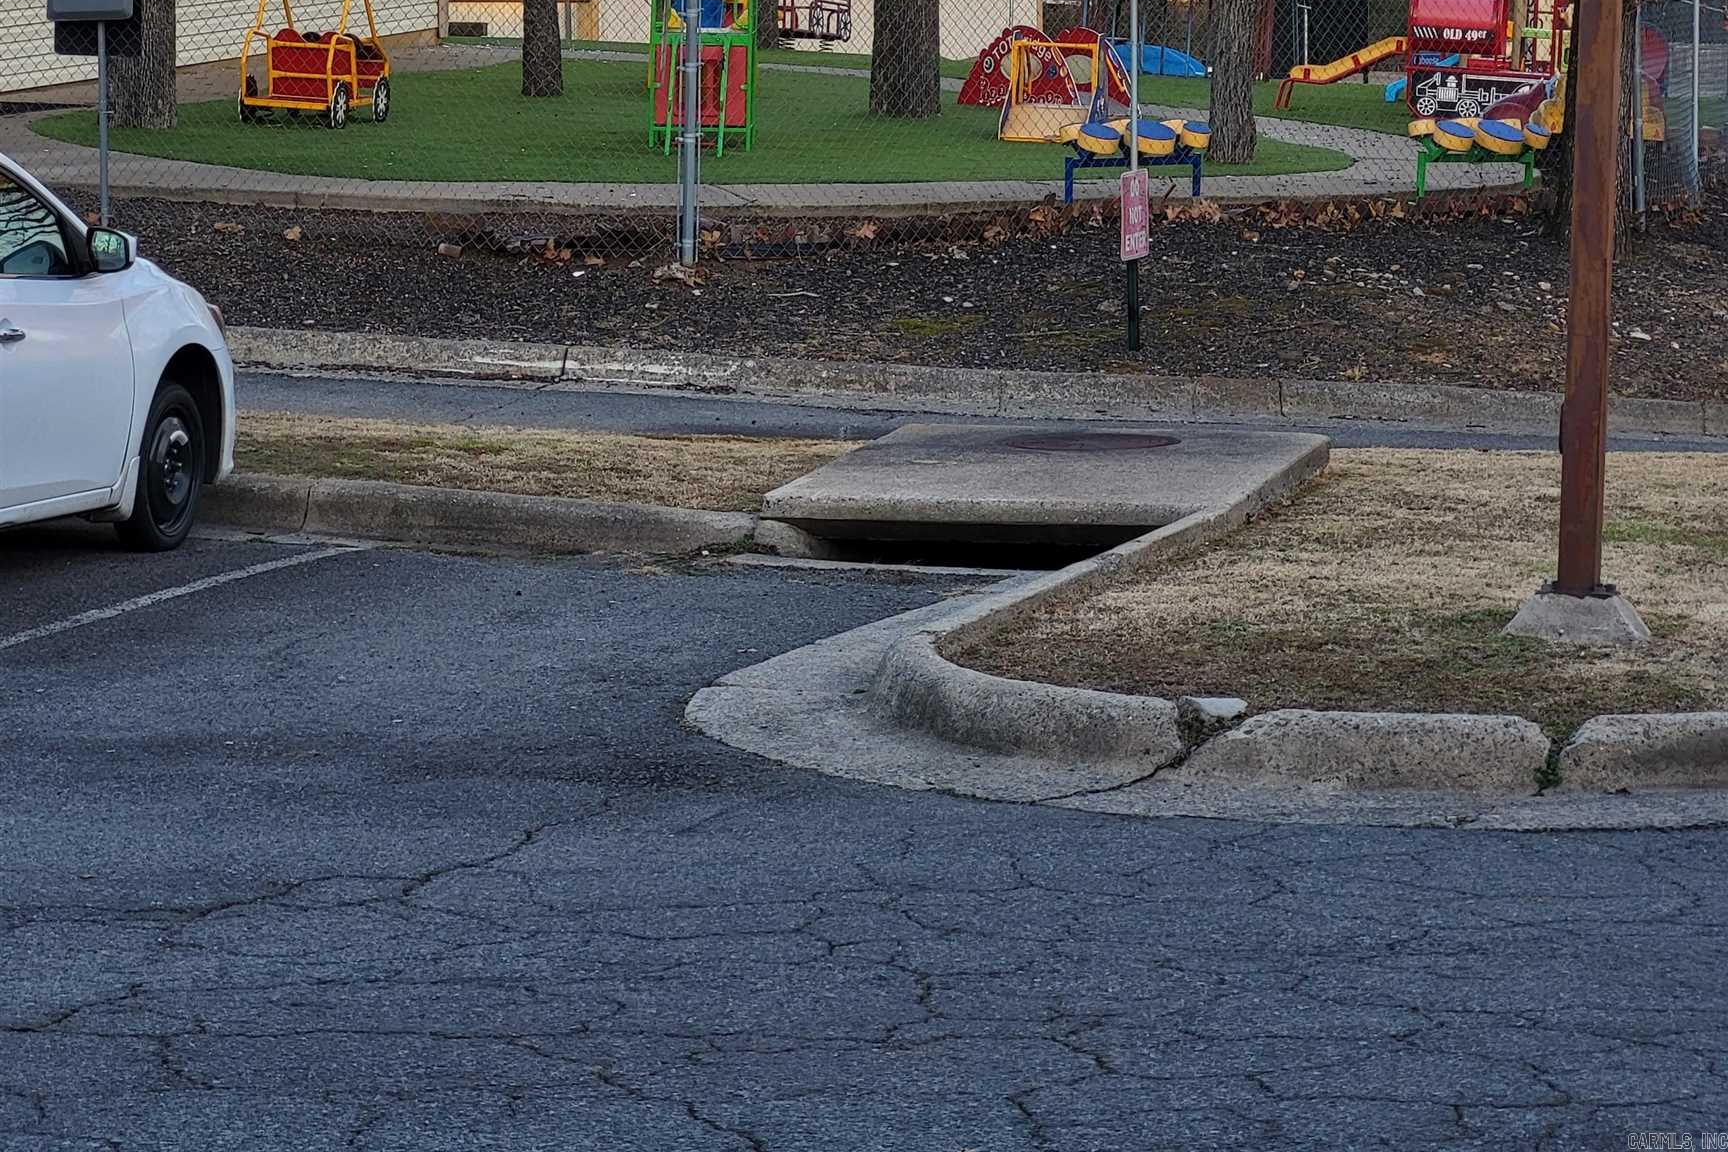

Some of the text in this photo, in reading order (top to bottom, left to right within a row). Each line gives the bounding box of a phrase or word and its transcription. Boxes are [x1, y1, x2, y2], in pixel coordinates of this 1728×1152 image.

[1443, 28, 1462, 40] OLD
[992, 36, 1013, 60] TOT
[1130, 179, 1140, 197] DO
[1129, 205, 1142, 225] NOT
[1125, 231, 1147, 252] ENTER
